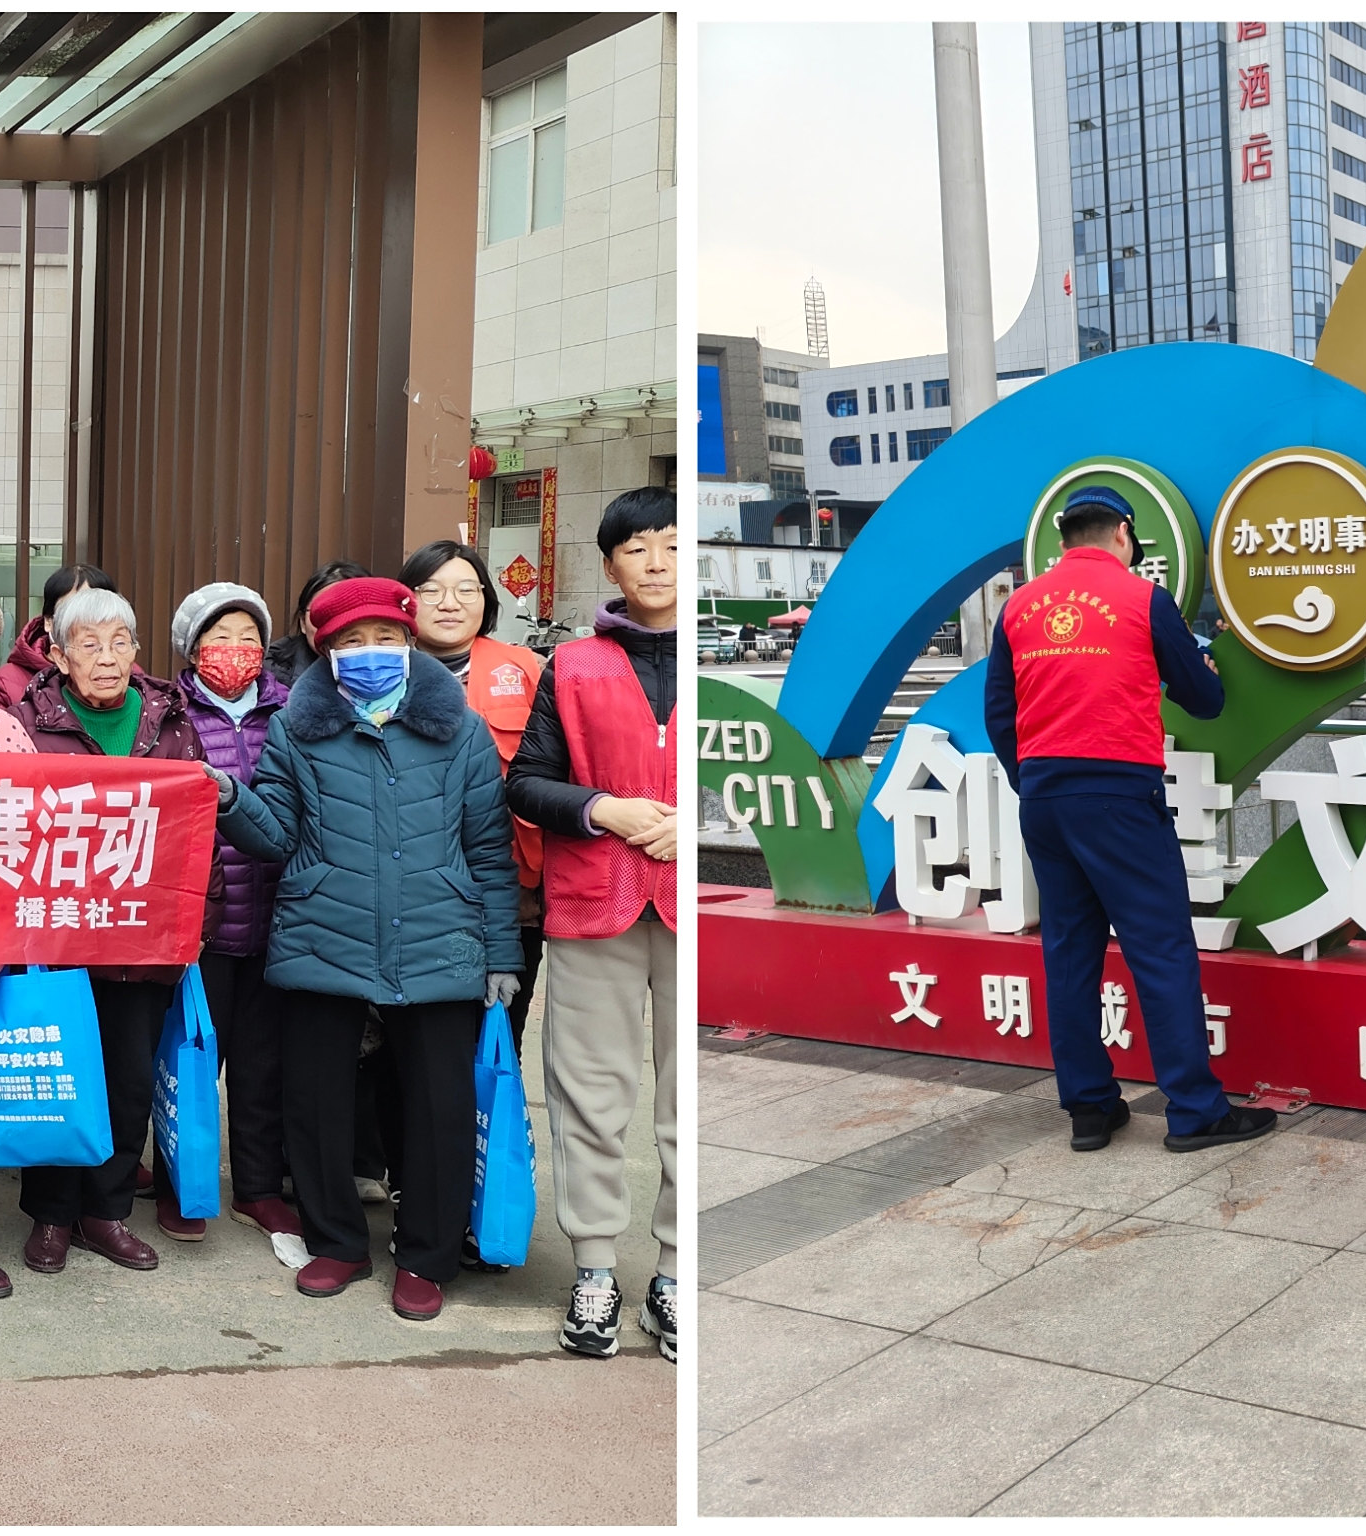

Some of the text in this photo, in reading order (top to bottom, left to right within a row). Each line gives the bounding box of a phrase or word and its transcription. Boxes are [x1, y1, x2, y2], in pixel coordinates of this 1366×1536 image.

[511, 561, 532, 584] 福
[1248, 565, 1273, 577] BAN
[723, 771, 834, 830] CITY
[16, 897, 148, 930] 播美社工
